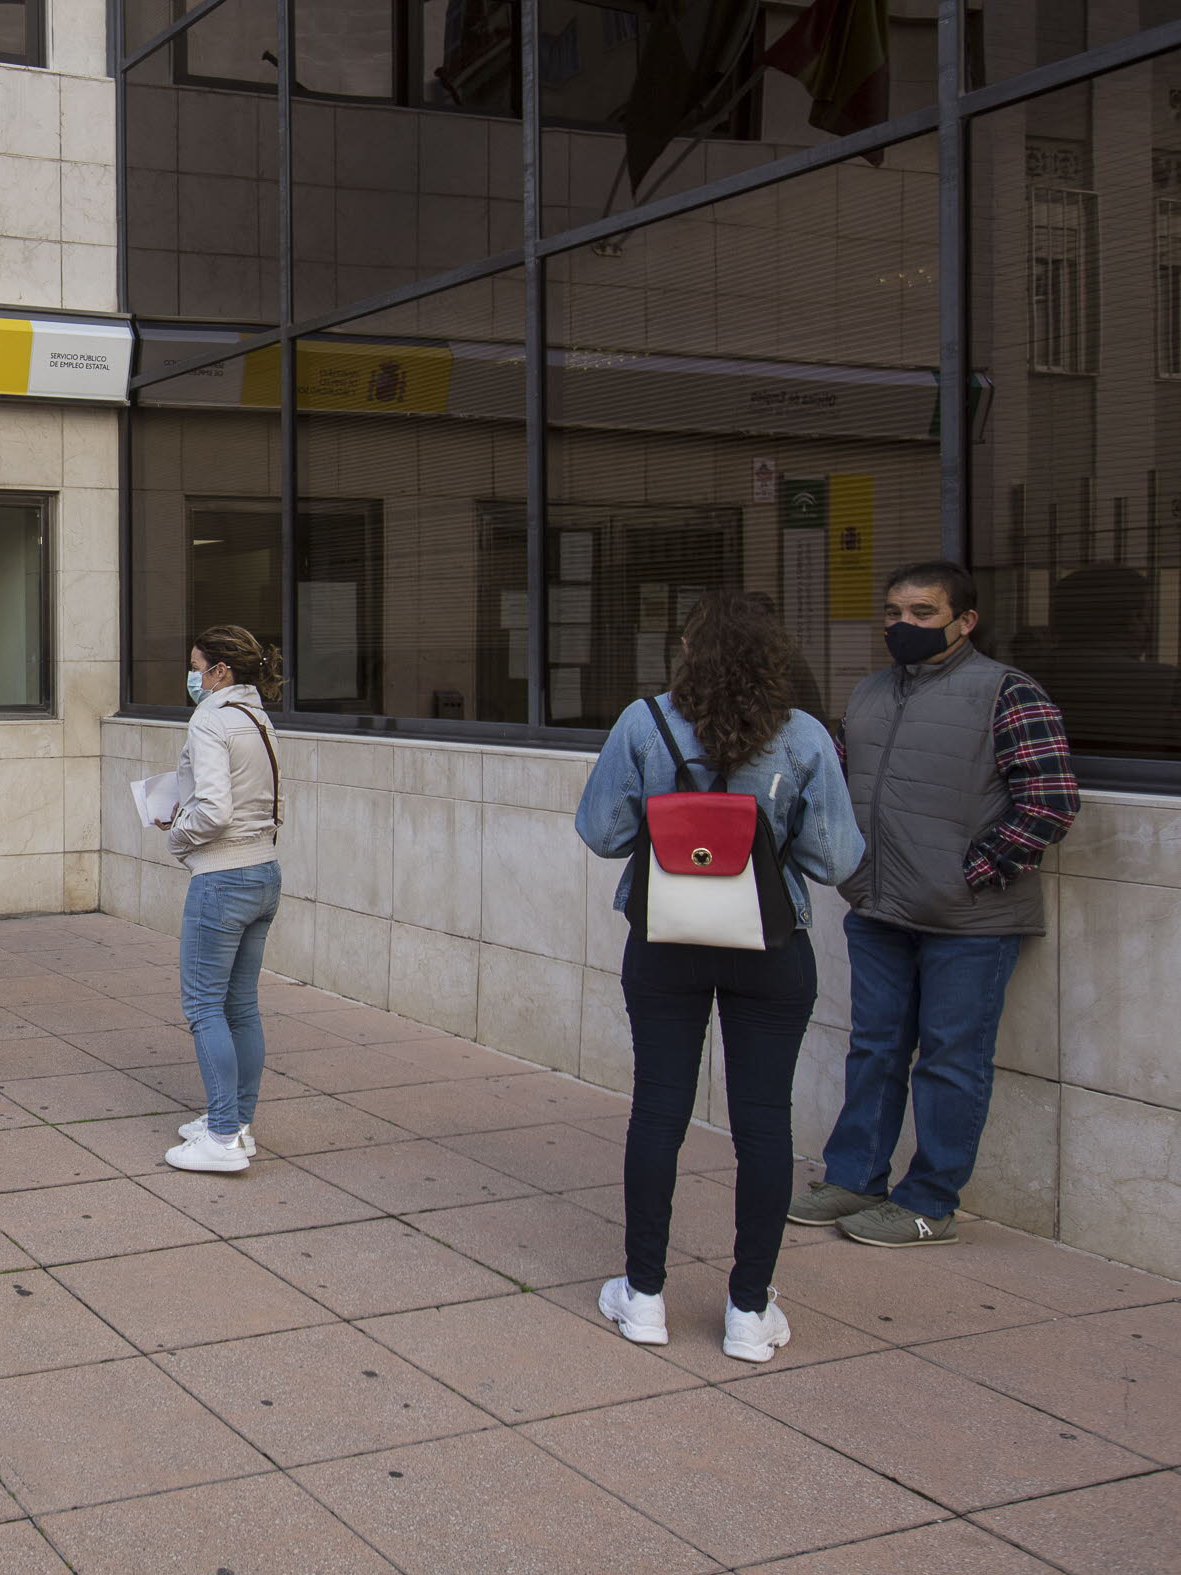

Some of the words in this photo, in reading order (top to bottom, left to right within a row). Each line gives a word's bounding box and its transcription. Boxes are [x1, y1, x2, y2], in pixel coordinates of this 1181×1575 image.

[51, 352, 78, 360] SERVICIO
[79, 353, 107, 362] PÚBLICO
[914, 1217, 933, 1239] A
